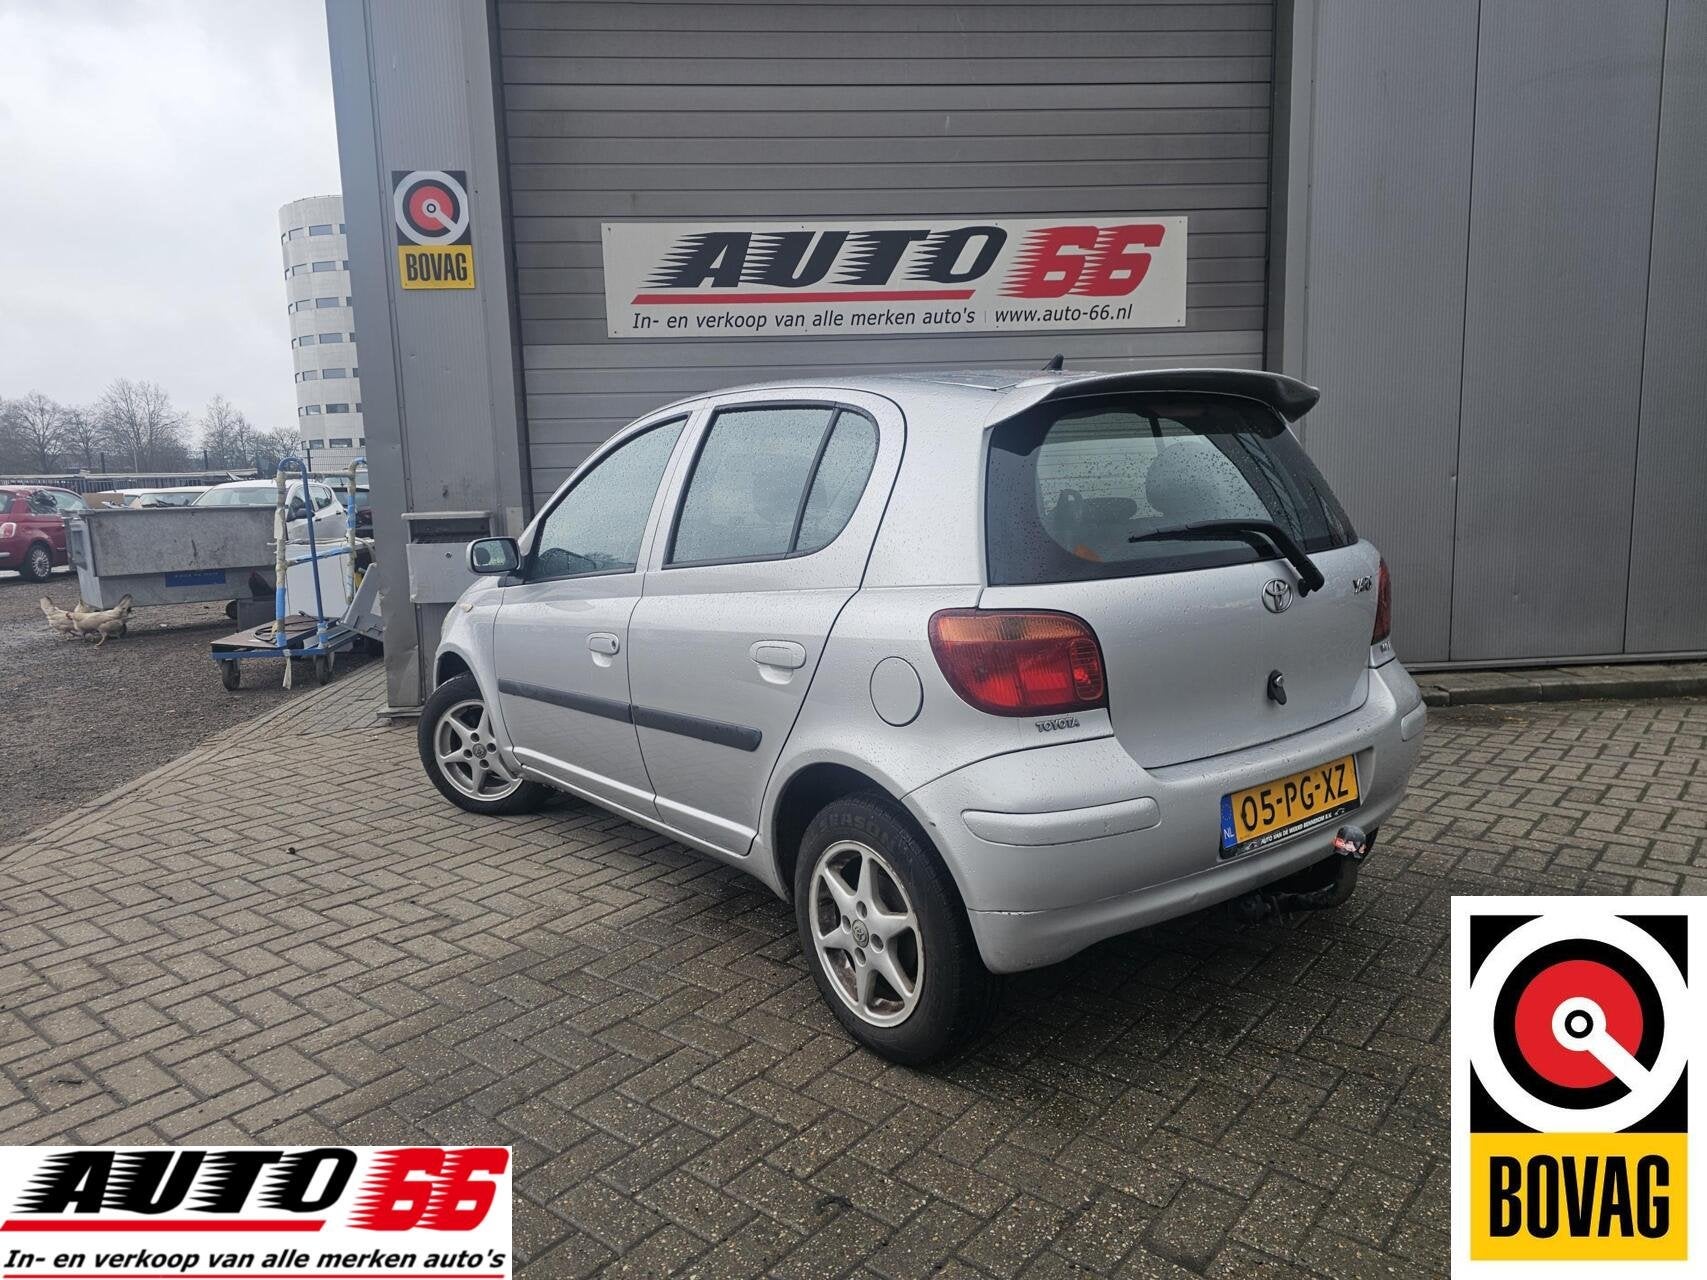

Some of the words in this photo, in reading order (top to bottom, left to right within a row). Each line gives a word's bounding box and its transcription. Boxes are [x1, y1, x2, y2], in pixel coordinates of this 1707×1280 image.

[405, 252, 468, 282] BOVAG
[637, 225, 1008, 289] AUTO
[997, 224, 1166, 298] 66
[632, 312, 660, 329] In-
[666, 316, 689, 329] en
[695, 311, 768, 331] verkoop
[774, 315, 806, 328] van
[812, 309, 844, 327] alle
[850, 308, 916, 326] merken
[922, 306, 976, 325] auto's
[994, 303, 1133, 323] www.auto-66.nl
[1035, 716, 1081, 733] TOYOTA
[1241, 763, 1349, 832] 05-PG-XZ
[1223, 828, 1235, 840] NL
